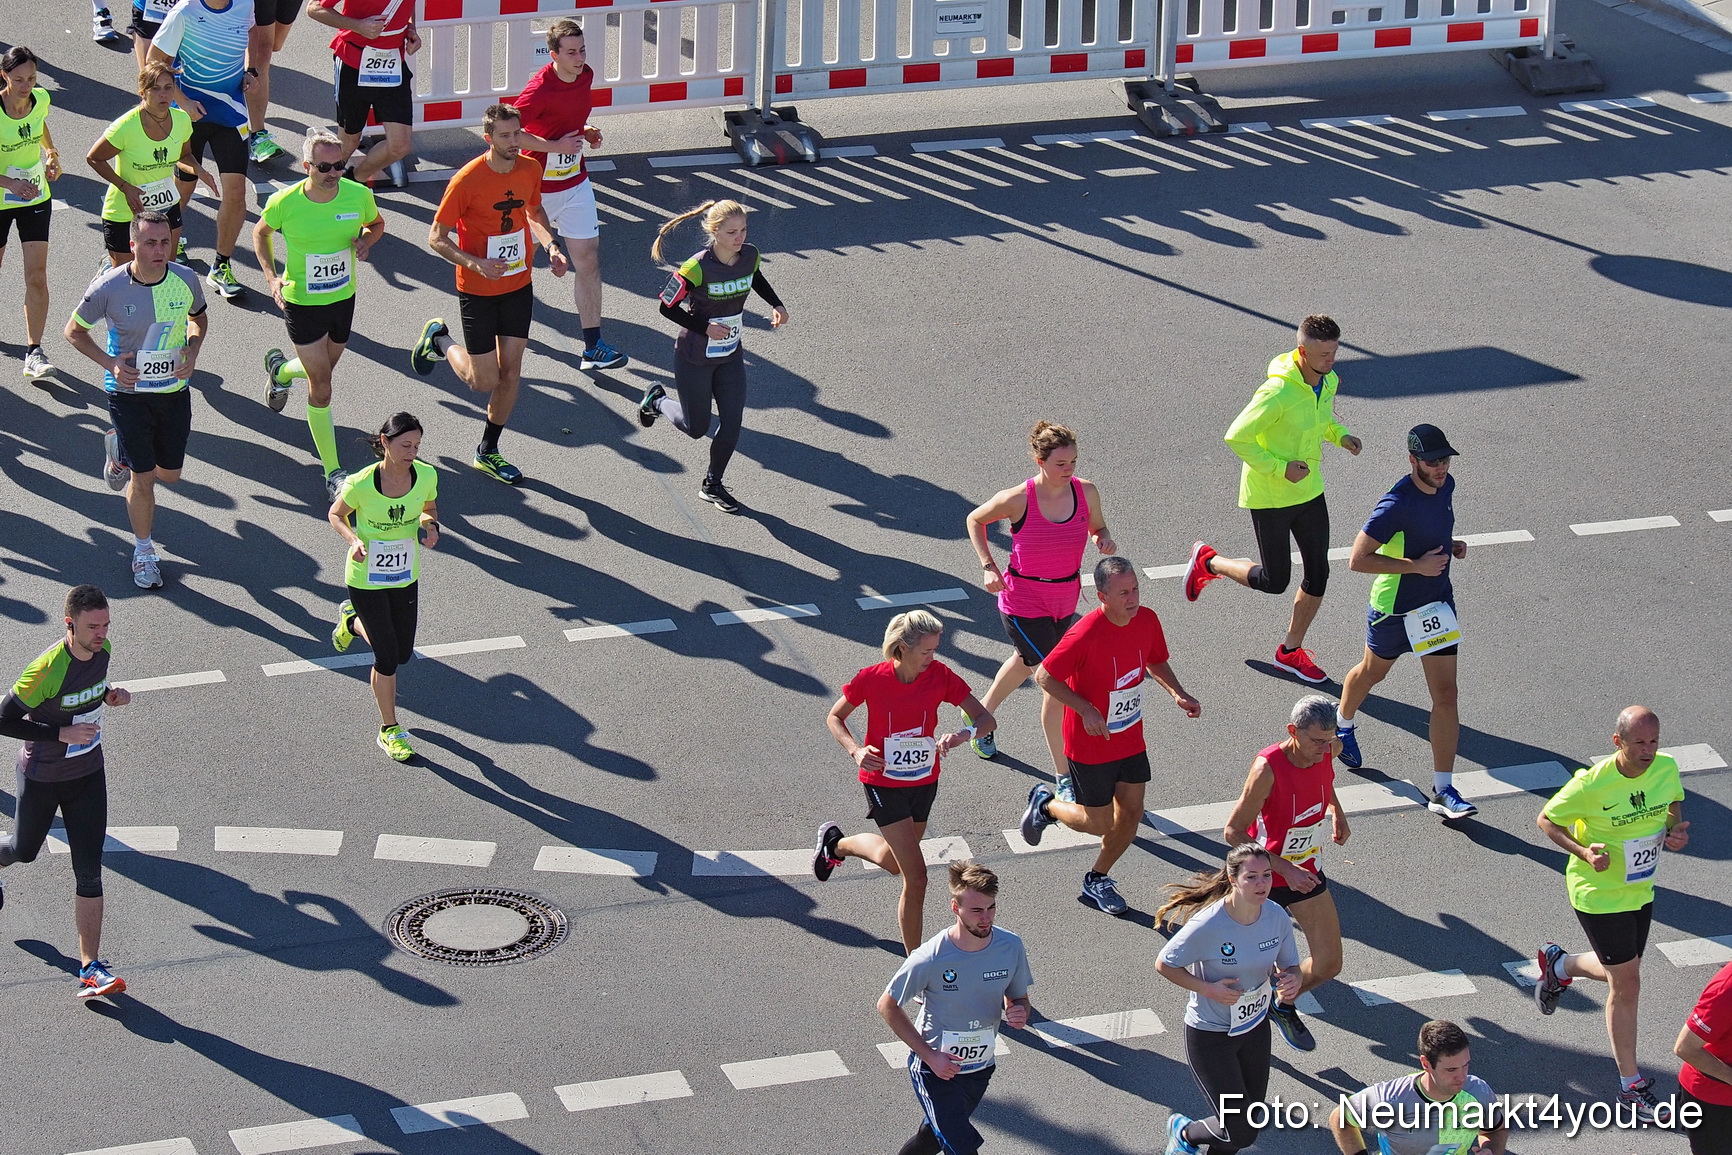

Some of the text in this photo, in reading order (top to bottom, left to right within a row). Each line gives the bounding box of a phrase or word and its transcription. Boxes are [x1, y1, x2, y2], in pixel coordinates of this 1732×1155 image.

[366, 57, 396, 69] 2615
[141, 189, 174, 207] 2300
[498, 243, 519, 259] 278
[313, 260, 346, 278] 2164
[143, 359, 175, 375] 2891
[148, 380, 170, 388] Norbert
[376, 552, 408, 568] 2211
[1422, 615, 1441, 633] 58
[1426, 636, 1447, 648] Stefan
[1114, 694, 1141, 716] 2436
[892, 749, 929, 765] 2435
[1259, 938, 1280, 949] BOCK
[983, 970, 1008, 979] BOCK
[1237, 993, 1267, 1021] 3050
[968, 1020, 982, 1030] 19.
